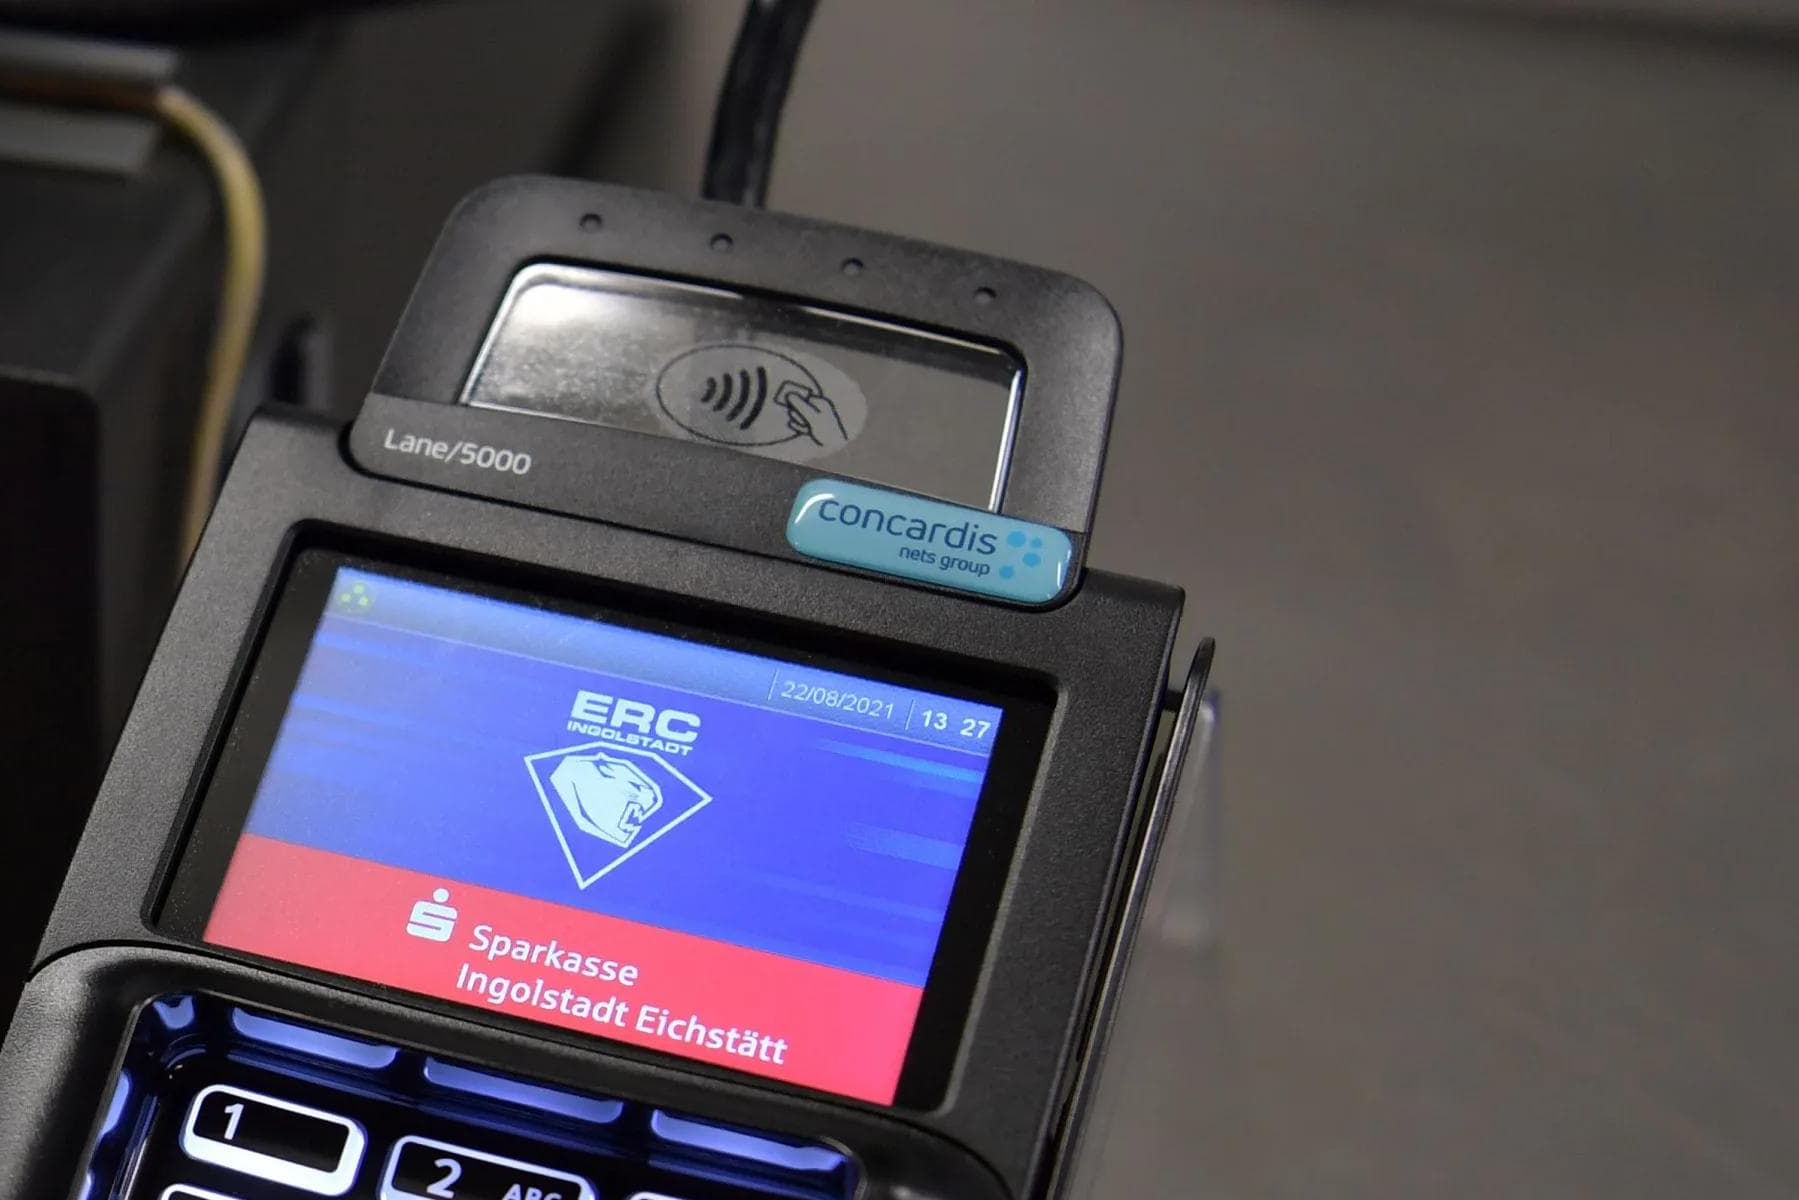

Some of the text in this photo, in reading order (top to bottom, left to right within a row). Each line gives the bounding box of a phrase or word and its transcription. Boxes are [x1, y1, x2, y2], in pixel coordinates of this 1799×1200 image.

[383, 427, 532, 476] Lane/5000
[817, 495, 998, 557] concardis
[898, 544, 991, 579] nets group
[570, 690, 702, 742] ERC
[780, 678, 992, 741] 22/08/2021 13 27
[567, 719, 695, 756] INGOLSTADT
[468, 923, 638, 987] Sparkasse
[456, 962, 788, 1066] Ingolstadt Eichstätt
[221, 1103, 244, 1140] 1
[426, 1158, 458, 1200] 2
